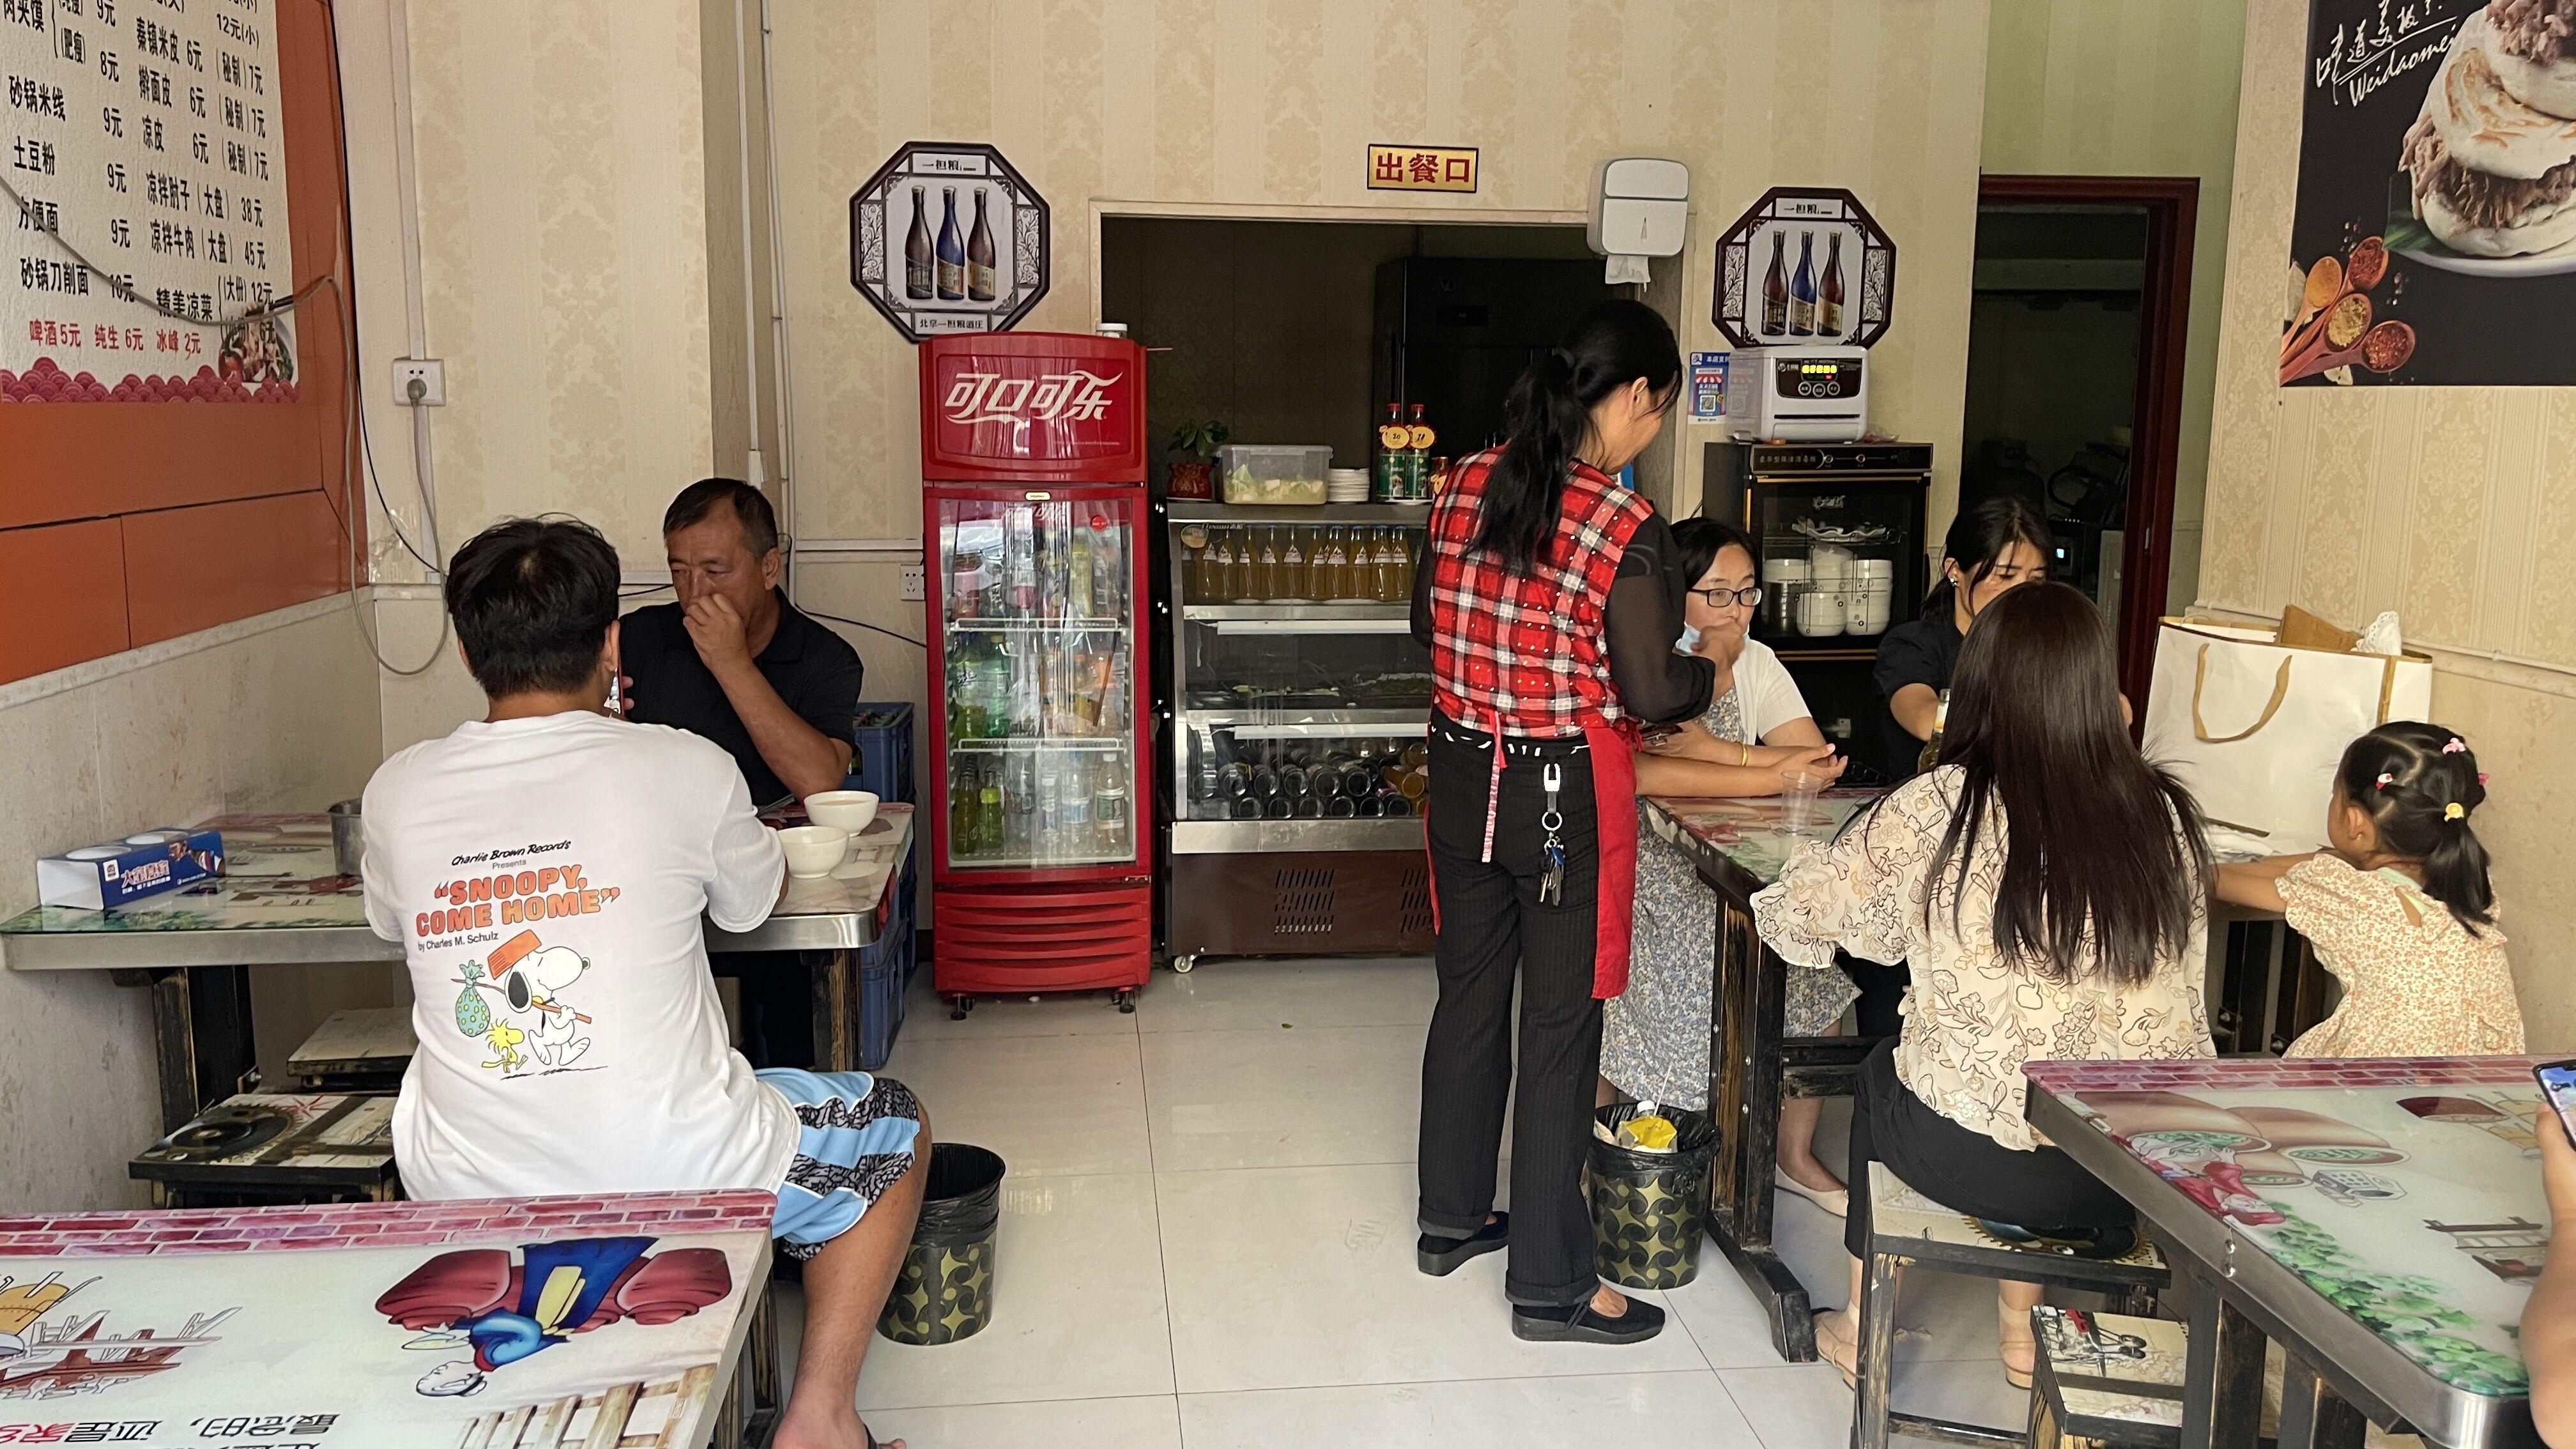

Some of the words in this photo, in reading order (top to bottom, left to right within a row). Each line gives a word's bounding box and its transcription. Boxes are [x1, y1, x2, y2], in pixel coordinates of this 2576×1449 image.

[97, 0, 116, 26] 9元
[100, 50, 119, 82] 8元
[136, 16, 180, 65] 秦镇米皮
[187, 40, 203, 72] 6元
[249, 65, 263, 95] 7元
[8, 75, 66, 122] 砂锅米线
[103, 107, 123, 138] 9元
[139, 63, 172, 109] 擀面皮
[190, 86, 206, 118] 6元
[252, 108, 266, 139] 7元
[13, 135, 55, 176] 土豆粉
[107, 163, 127, 193] 9元
[142, 114, 164, 153] 凉皮
[192, 132, 209, 164] 6元
[254, 151, 268, 180] 7元
[1376, 153, 1471, 183] 出餐口
[19, 195, 59, 235] 方便面
[111, 218, 130, 248] 9元
[146, 170, 190, 212] 凉拌肘子
[241, 197, 263, 228] 38元
[150, 218, 195, 259] 凉拌牛肉
[244, 241, 266, 270] 45元
[20, 256, 89, 296] 砂锅刀削面
[110, 274, 135, 303] 10元
[156, 287, 213, 321] 精美凉菜
[29, 318, 57, 347] 啤酒
[60, 323, 81, 348] 5元
[95, 324, 119, 350] 纯生
[125, 328, 144, 351] 6元
[156, 328, 179, 353] 冰峰
[184, 332, 201, 356] 2元
[945, 370, 1123, 424] 可口可乐
[452, 852, 487, 866] Charlie
[489, 847, 526, 861] Brown
[527, 839, 572, 855] Records
[492, 859, 526, 870] Presents
[416, 903, 493, 937] COME
[417, 942, 425, 952] by
[425, 938, 452, 950] Charles
[454, 935, 465, 946] M.
[467, 931, 499, 944] Schulz
